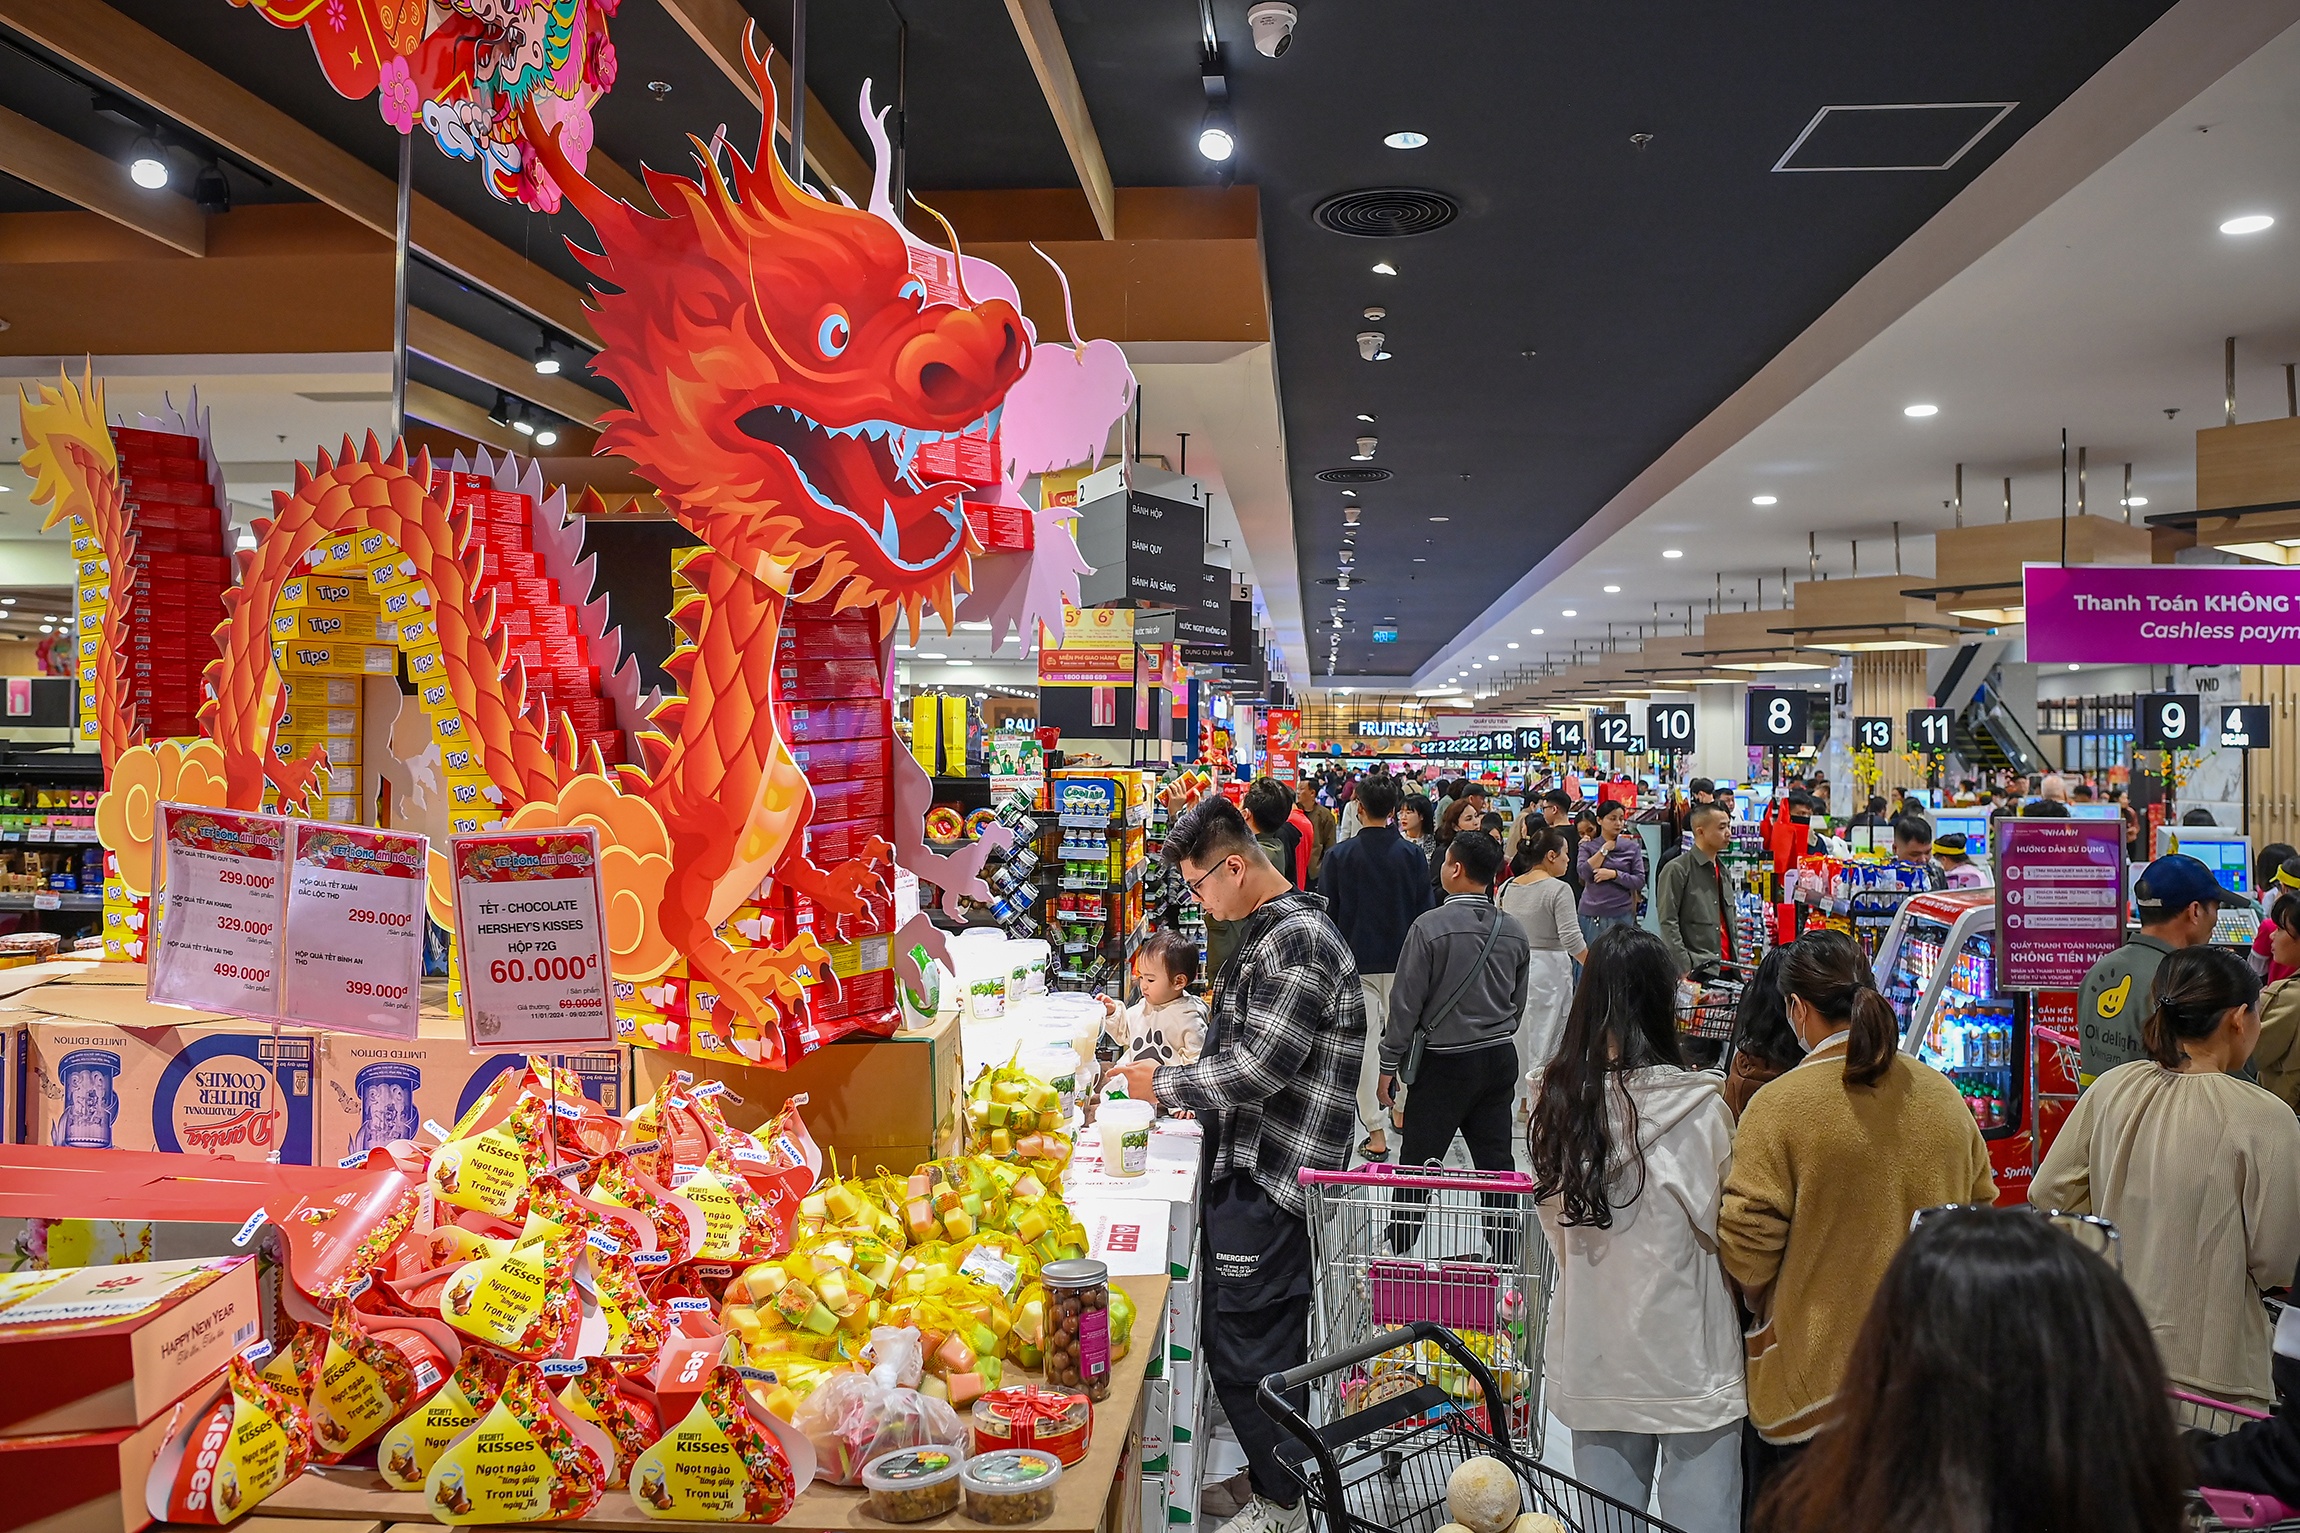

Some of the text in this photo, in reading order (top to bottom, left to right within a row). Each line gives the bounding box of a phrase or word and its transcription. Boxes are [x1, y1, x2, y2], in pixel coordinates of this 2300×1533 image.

[1119, 469, 1123, 487] 1
[1080, 485, 1084, 501] 2
[1192, 483, 1199, 501] 1
[1132, 504, 1163, 519] BÁNH HỘP
[330, 541, 350, 559] Tipo
[361, 534, 382, 553] Tipo
[1132, 540, 1162, 554] BÁNH QUY
[373, 564, 393, 583] Tipo
[1131, 576, 1176, 593] BÁNH ĂN SÁNG
[317, 585, 349, 602] Tipo
[1241, 588, 1248, 598] 5
[2074, 591, 2289, 613] Thanh Toán KHÔNG
[309, 618, 341, 634] Tipo
[2140, 621, 2234, 639] Cashless
[297, 650, 329, 666] Tipo
[1211, 648, 1223, 656] NHÀ
[1224, 647, 1234, 656] BẾP
[2196, 678, 2219, 692] VND
[424, 685, 445, 704] Tipo
[1656, 709, 1691, 739] 10
[1768, 697, 1792, 735] 8
[2161, 702, 2186, 739] 9
[2225, 708, 2243, 733] 4
[1005, 718, 1035, 732] RAU
[1600, 718, 1628, 743] 12
[1922, 715, 1948, 744] 11
[1494, 733, 1513, 750] 18
[1520, 730, 1541, 749] 16
[1556, 724, 1580, 745] 14
[1861, 721, 1889, 746] 13
[1462, 738, 1477, 752] 22
[1628, 737, 1643, 752] 21
[219, 870, 275, 889] 299.000đ
[479, 900, 578, 914] TẾT CHOCOLATE
[348, 908, 412, 927] 299.000đ
[217, 916, 273, 936] 329.000đ
[478, 920, 583, 934] HERSHEY'S KISSES
[508, 940, 557, 954] HỘP 72G
[2063, 941, 2084, 949] TOÁN
[295, 950, 309, 959] HỘP
[325, 952, 336, 961] TẾT
[295, 958, 308, 966] THD
[2010, 950, 2082, 963] KHÔNG TIỀN
[213, 962, 270, 982] 499.000đ
[490, 954, 597, 984] 60.000đ
[346, 980, 408, 1000] 399.000đ
[517, 1003, 527, 1011] Giá
[2057, 1005, 2073, 1014] KẾT
[2057, 1015, 2074, 1023] NÊN
[54, 1036, 127, 1046] LIMITED EDITION
[350, 1049, 427, 1059] LIMITED EDITION
[196, 1072, 266, 1085] COOKIES
[200, 1089, 261, 1109] BUTTER
[184, 1105, 237, 1117] TRADITIONAL
[1216, 1253, 1260, 1262] EMERGENCY
[161, 1303, 235, 1359] HAPPY NEW YEAR
[476, 1462, 536, 1476] Ngọt ngào
[675, 1463, 730, 1476] Ngọt ngào
[486, 1487, 533, 1502] Trọn vui
[685, 1488, 729, 1500] Trọn vui
